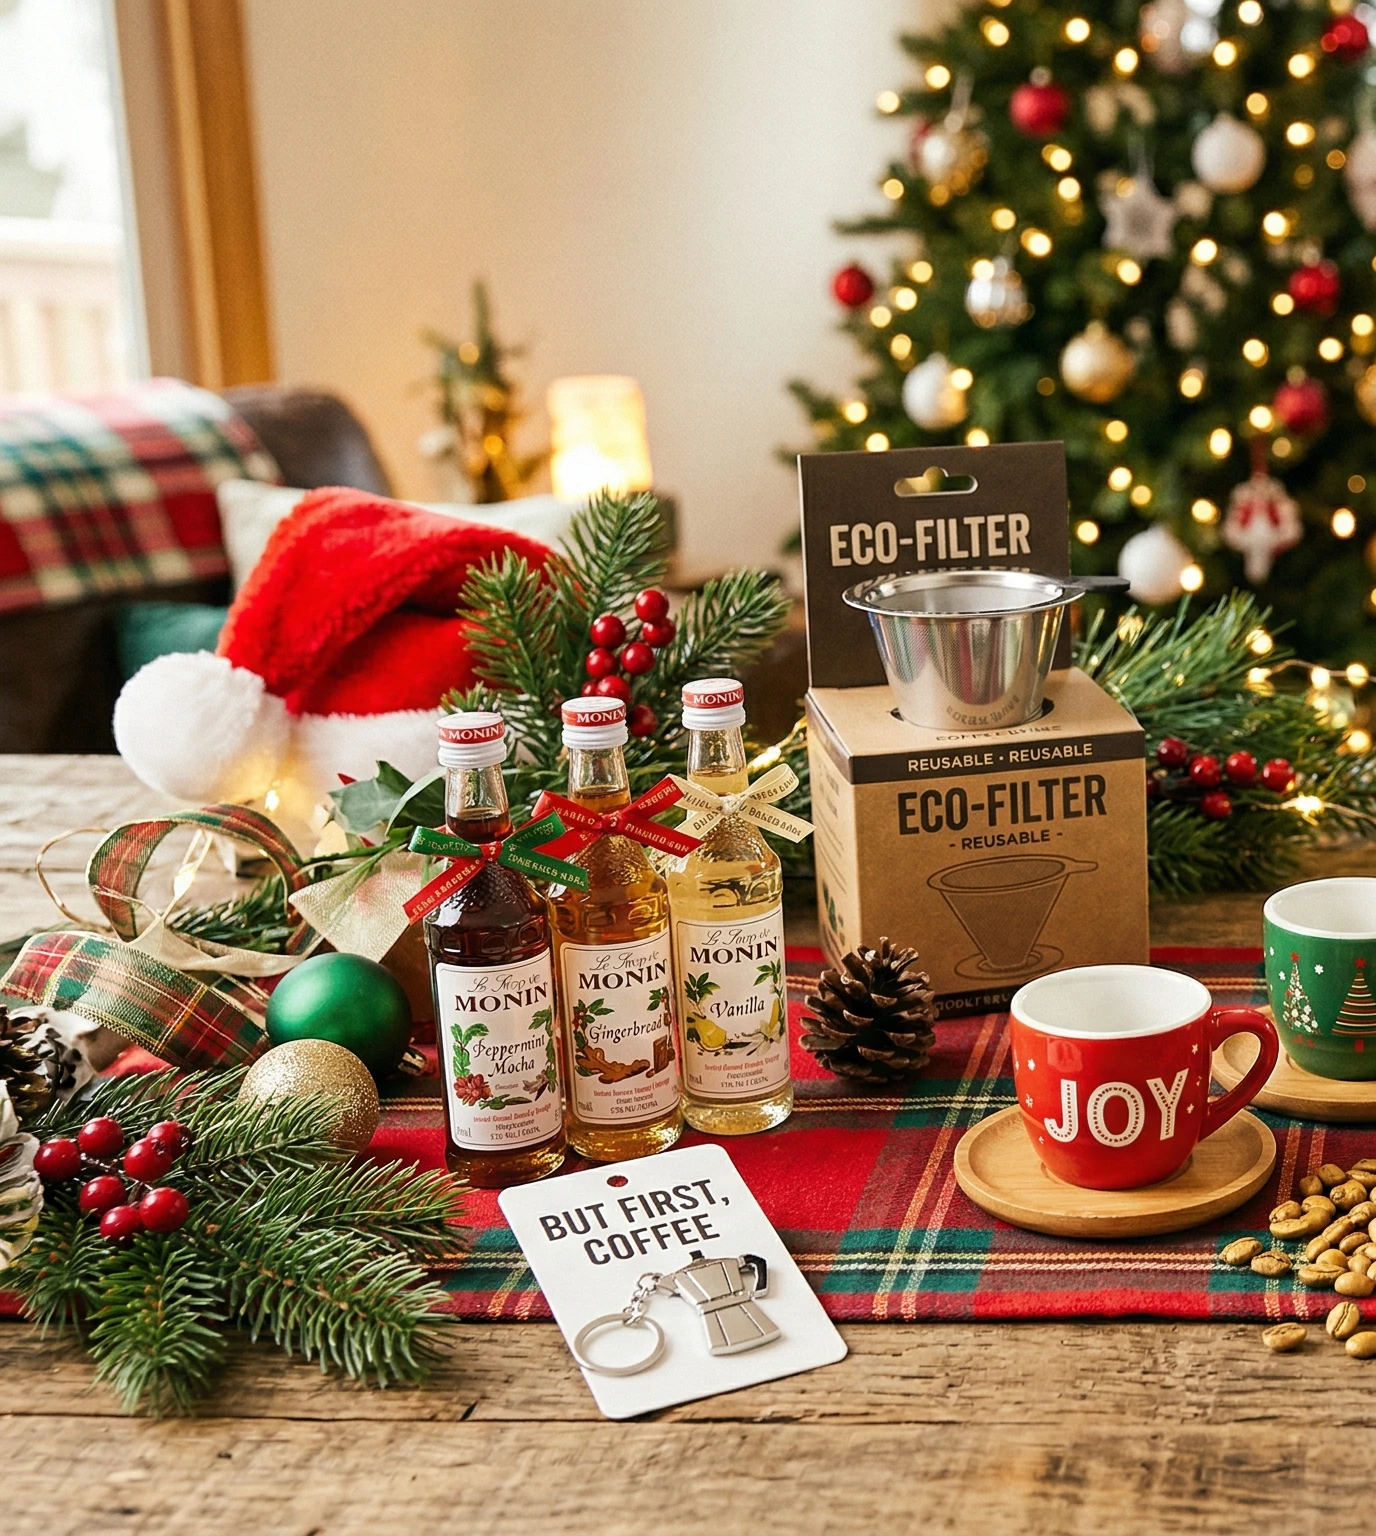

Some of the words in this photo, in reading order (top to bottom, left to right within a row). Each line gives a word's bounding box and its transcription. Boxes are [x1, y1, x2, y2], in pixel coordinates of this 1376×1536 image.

[830, 513, 1031, 566] ECO-FILTER
[693, 691, 740, 705] MONIN
[448, 725, 500, 741] MONIN
[908, 752, 994, 773] REUSABLE
[1009, 743, 1093, 764] REUSABLE
[897, 774, 1107, 836] ECO-FILTER
[961, 829, 1051, 851] REUSABLE
[690, 938, 777, 964] MONIN
[578, 958, 668, 990] MONIN
[455, 982, 549, 1012] MONIN
[710, 996, 765, 1018] Vanilla
[589, 1014, 664, 1044] Gingerbread
[472, 1034, 546, 1063] Peppermint
[488, 1055, 535, 1078] Mocha
[1043, 1068, 1189, 1148] JOY
[538, 1202, 610, 1242] BUT
[616, 1179, 730, 1224] FIRST,
[583, 1213, 721, 1266] COFFEE
